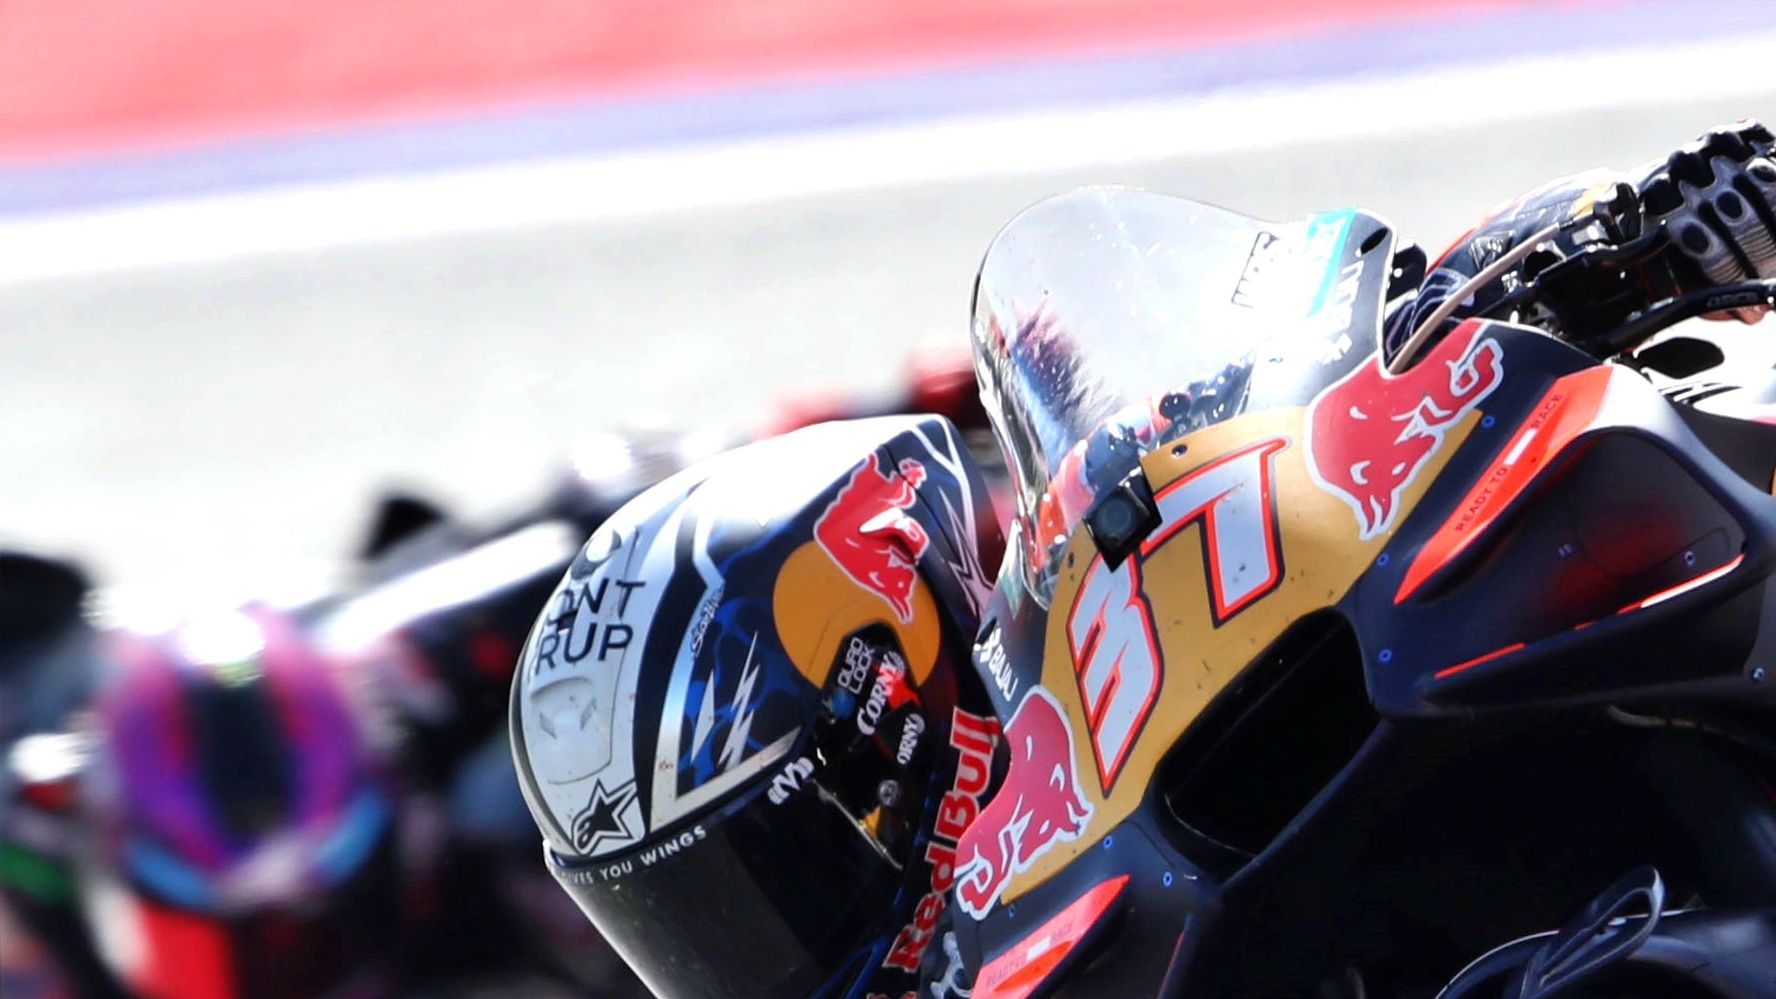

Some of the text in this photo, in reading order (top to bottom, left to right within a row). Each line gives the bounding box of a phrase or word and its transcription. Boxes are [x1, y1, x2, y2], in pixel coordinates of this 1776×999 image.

[850, 645, 876, 694] LOCK
[1066, 436, 1292, 800] 37
[600, 860, 632, 881] YOU
[640, 825, 707, 867] WINGS
[881, 705, 1002, 974] Red Bull
